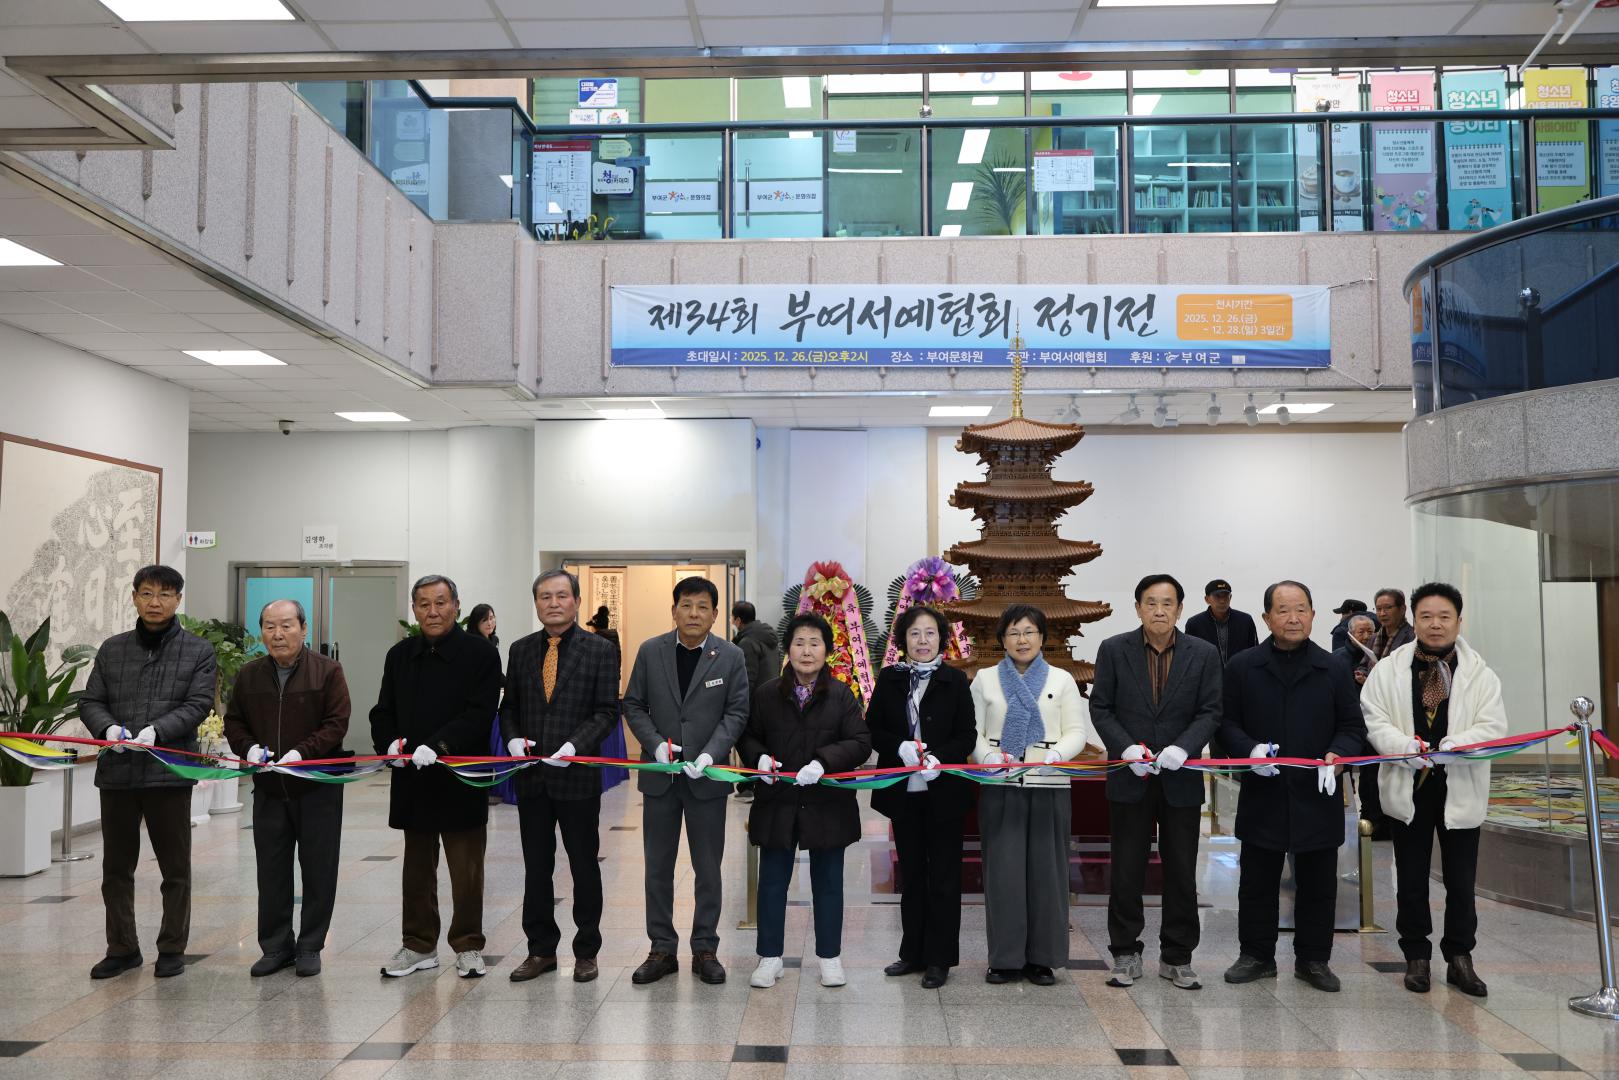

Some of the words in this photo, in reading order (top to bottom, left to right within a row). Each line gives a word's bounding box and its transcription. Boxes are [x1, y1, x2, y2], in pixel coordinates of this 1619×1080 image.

[1387, 89, 1419, 103] 청소년
[1537, 85, 1572, 99] 청소년
[1448, 90, 1498, 110] 청소년
[1215, 299, 1254, 310] 전시기간
[647, 296, 759, 336] 제34회
[778, 290, 1012, 342] 부여서예협회
[1033, 292, 1158, 341] 정기전
[1183, 313, 1209, 323] 2025.
[1212, 313, 1225, 323] 12.
[1227, 313, 1258, 324] 26.(금)
[1212, 325, 1225, 335] 12.
[1227, 325, 1258, 336] 28.(일)
[1260, 325, 1286, 336] 3일간
[686, 350, 731, 363] 초대일시
[740, 351, 770, 362] 2025.
[774, 351, 789, 362] 12.
[791, 350, 868, 363] 26.(금)오후2시
[890, 351, 914, 363] 장소
[926, 351, 983, 363] 부여문화원
[1039, 351, 1107, 363] 부여서예협회
[1129, 351, 1153, 363] 후원
[1181, 352, 1221, 364] 부여군
[850, 621, 873, 694] 부여서예협회
